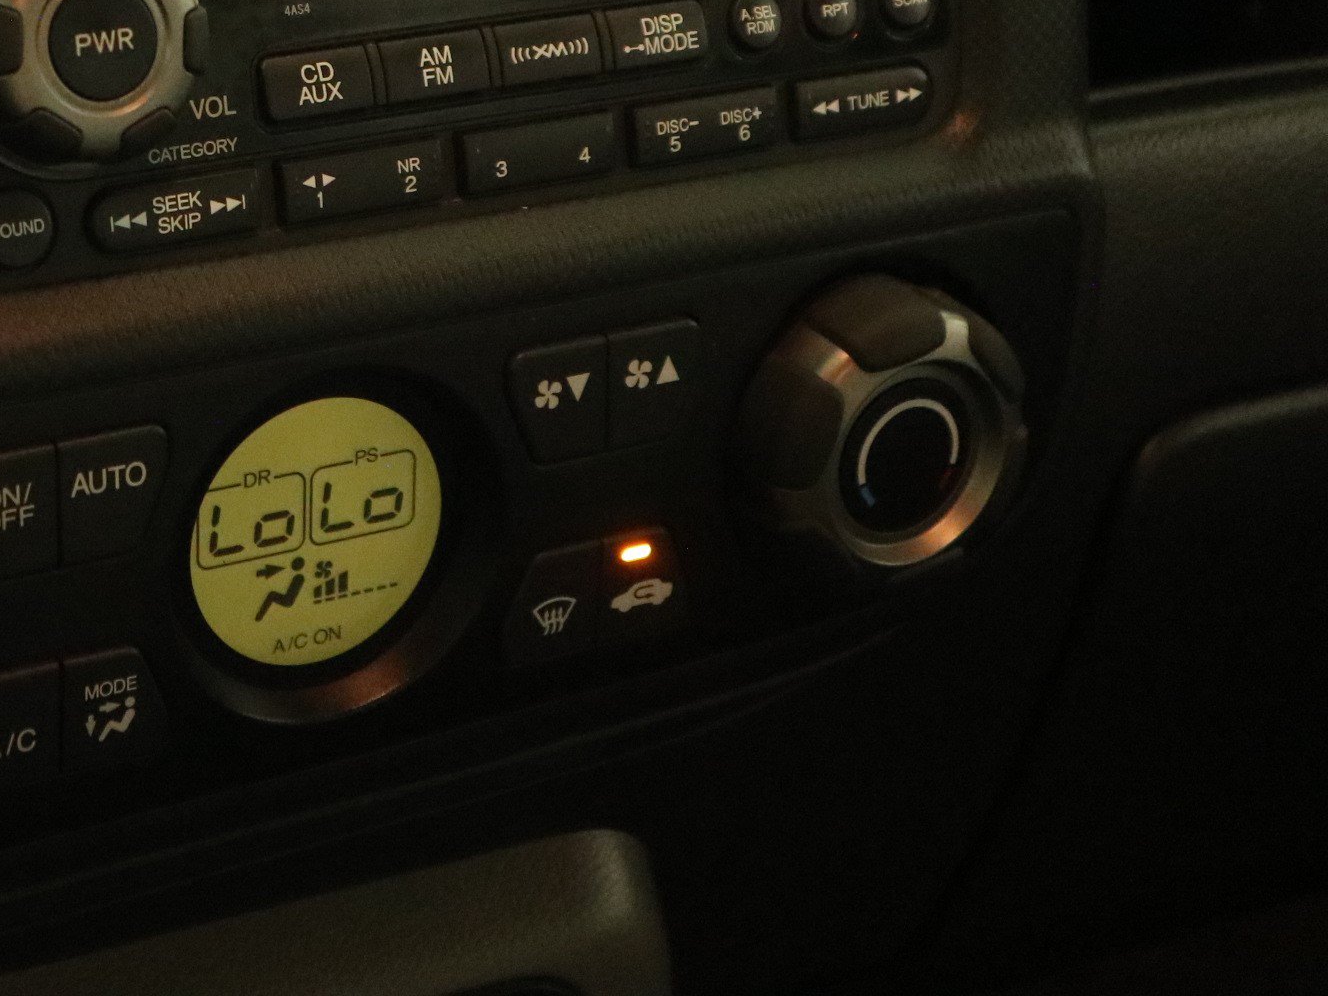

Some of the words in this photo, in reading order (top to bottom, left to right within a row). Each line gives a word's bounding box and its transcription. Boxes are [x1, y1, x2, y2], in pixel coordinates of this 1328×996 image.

[283, 2, 312, 17] 4AS4
[741, 5, 777, 22] A.SEL
[821, 2, 850, 18] RPT
[639, 13, 684, 37] DISP
[746, 20, 776, 35] RDM
[74, 28, 135, 57] PWR
[644, 30, 700, 56] MODE
[419, 45, 453, 68] AM
[300, 61, 335, 84] CD
[422, 66, 455, 88] FM
[299, 81, 344, 106] AUX
[846, 90, 890, 111] TUNE
[189, 96, 237, 121] VOL
[720, 105, 764, 126] DISC+
[656, 118, 700, 137] DISC-
[738, 123, 751, 142] 6
[147, 136, 239, 165] CATEGORY
[669, 135, 682, 153] 5
[397, 157, 421, 174] NR
[578, 146, 592, 164] 4
[495, 160, 508, 178] 3
[404, 174, 418, 194] 2
[152, 190, 203, 214] SEEK
[316, 191, 324, 209] 1
[157, 211, 202, 235] SKIP
[354, 448, 379, 466] PS
[71, 461, 147, 498] AUTO
[243, 470, 272, 488] DR
[320, 482, 404, 533] Lo
[209, 504, 295, 559] Lo
[273, 632, 309, 655] A/C
[313, 625, 343, 644] ON
[84, 675, 138, 703] MODE
